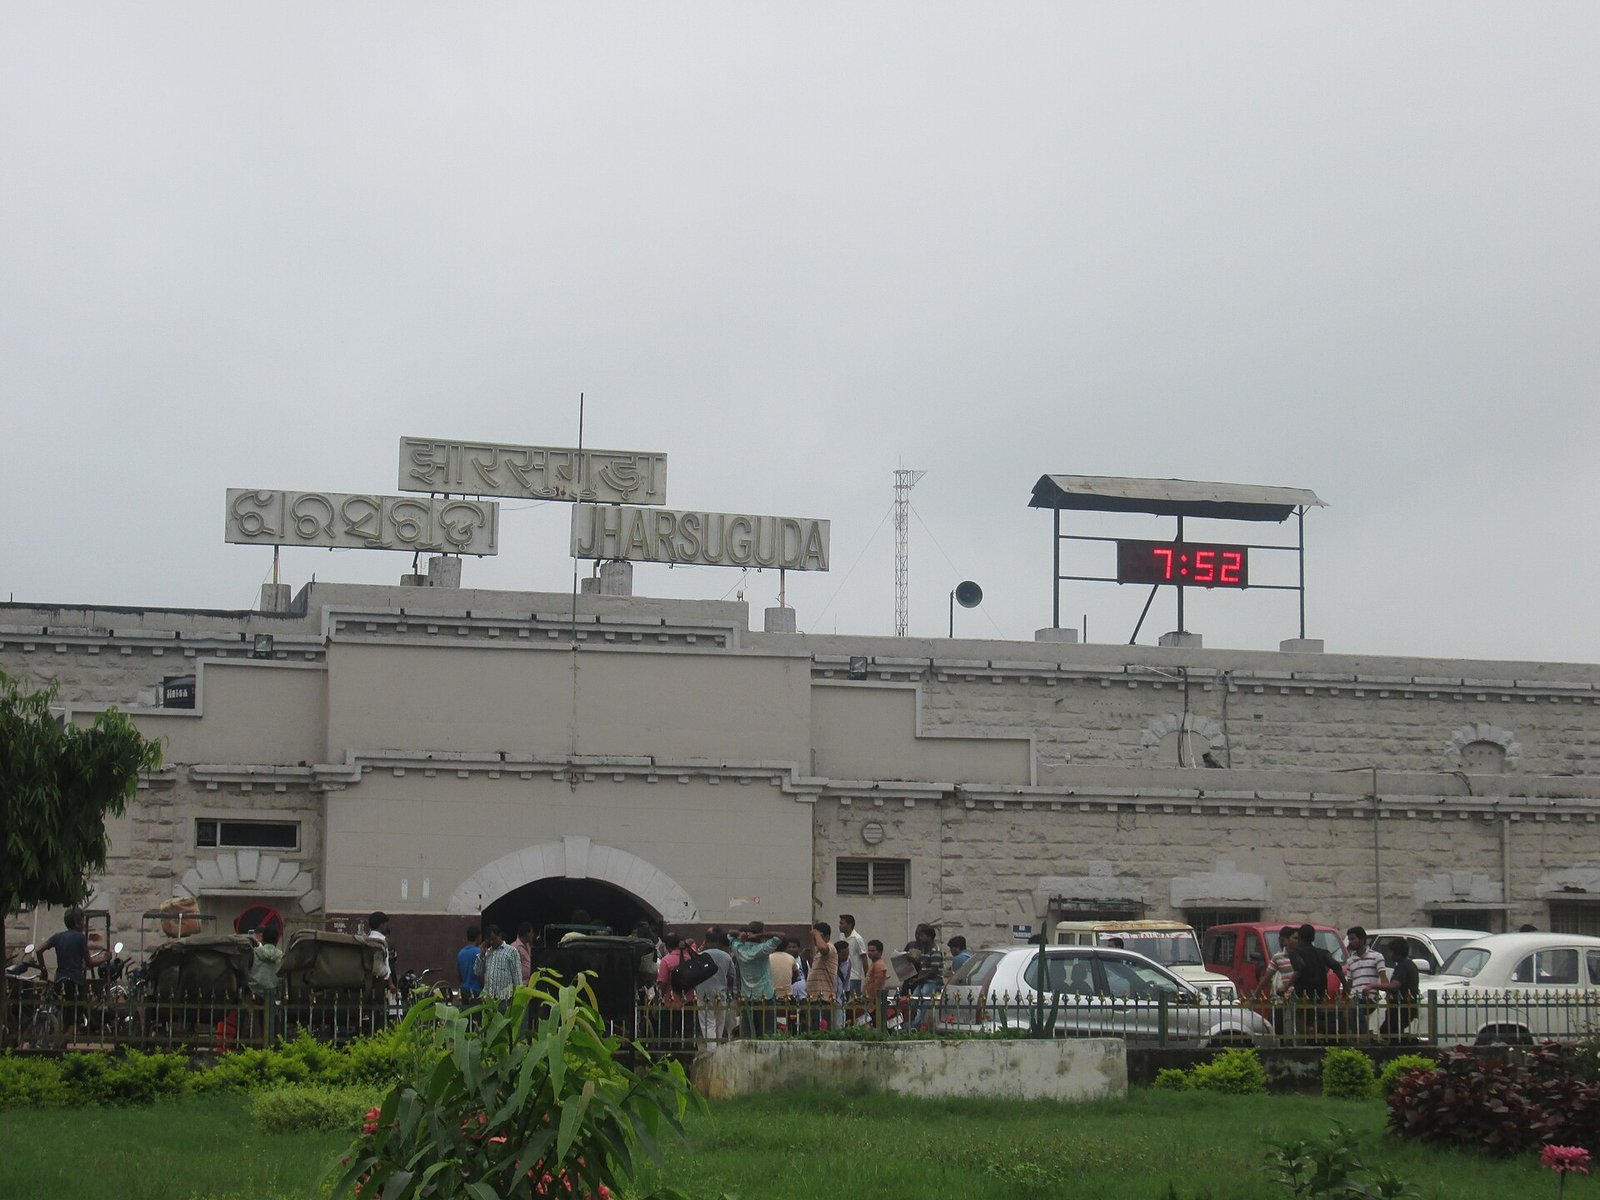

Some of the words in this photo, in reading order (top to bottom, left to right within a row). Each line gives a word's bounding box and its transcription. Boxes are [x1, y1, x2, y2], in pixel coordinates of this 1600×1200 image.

[405, 440, 664, 499] झारसुगुड़ा
[577, 506, 826, 570] JHARSUGUDA
[1153, 549, 1241, 582] 7:52
